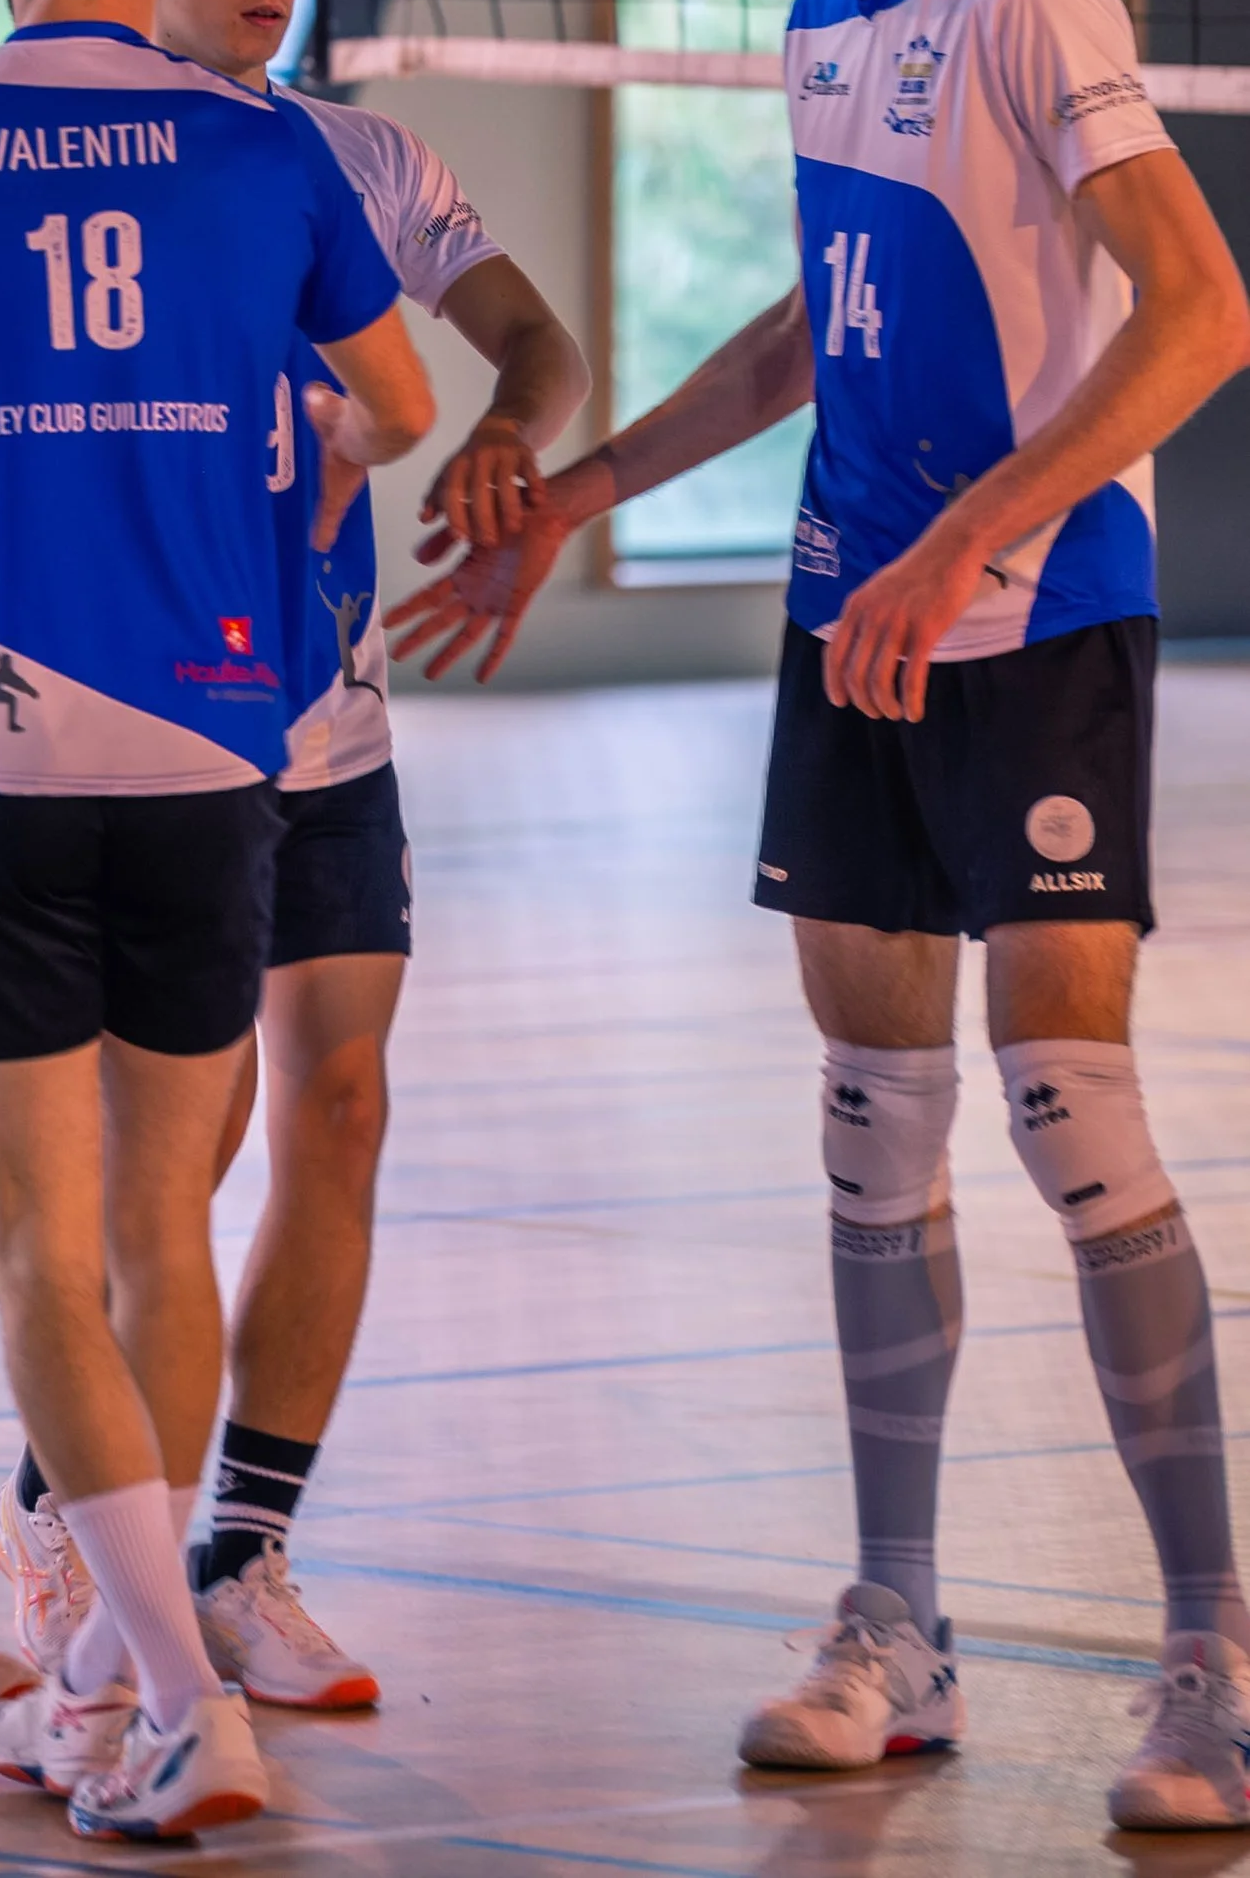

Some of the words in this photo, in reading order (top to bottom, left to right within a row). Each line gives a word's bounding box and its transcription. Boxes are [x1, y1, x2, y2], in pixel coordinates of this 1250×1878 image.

[25, 209, 145, 352] 18
[823, 231, 883, 359] 14
[28, 403, 87, 433] CLUB
[1029, 872, 1107, 893] ALLSIX
